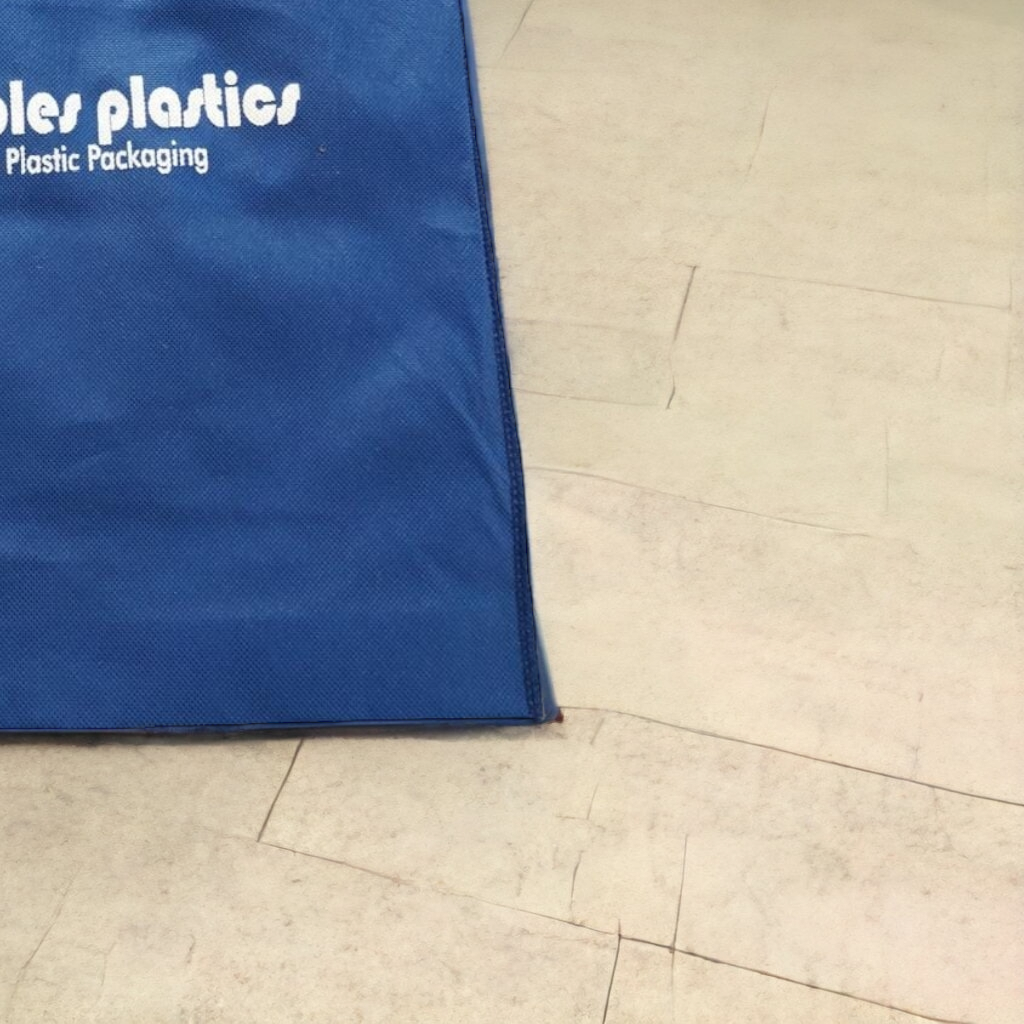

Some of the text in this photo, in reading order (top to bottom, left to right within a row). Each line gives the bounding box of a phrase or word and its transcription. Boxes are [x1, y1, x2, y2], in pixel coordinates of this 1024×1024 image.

[97, 70, 301, 145] plastics
[5, 144, 81, 176] Plastic
[87, 140, 209, 175] Packaging
